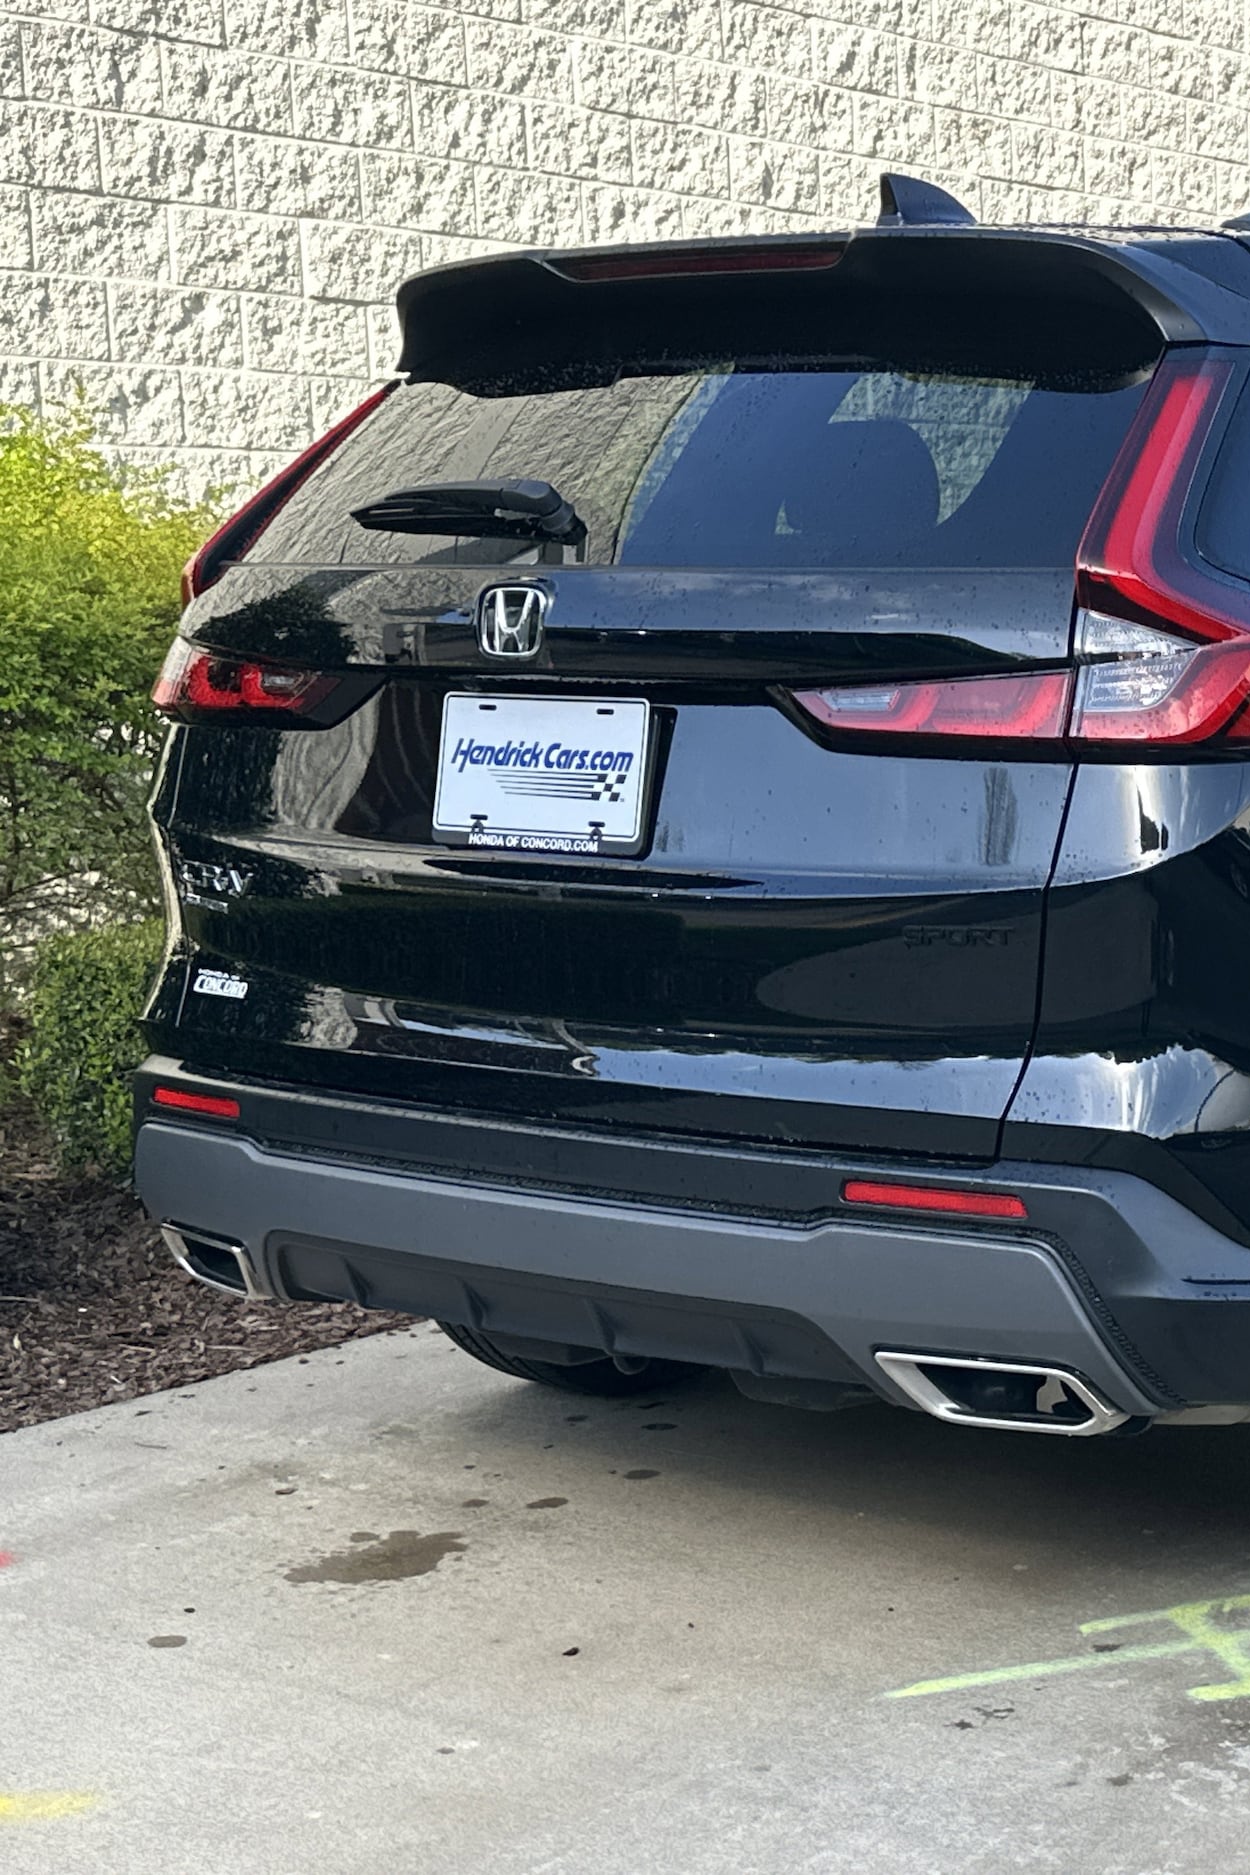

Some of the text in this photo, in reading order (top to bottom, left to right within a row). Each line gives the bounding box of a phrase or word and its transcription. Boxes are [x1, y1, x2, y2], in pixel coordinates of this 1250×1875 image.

[468, 833, 598, 853] HONDA OF CONCORD.COM
[903, 924, 1015, 946] SPORT
[193, 975, 248, 999] CONCORD
